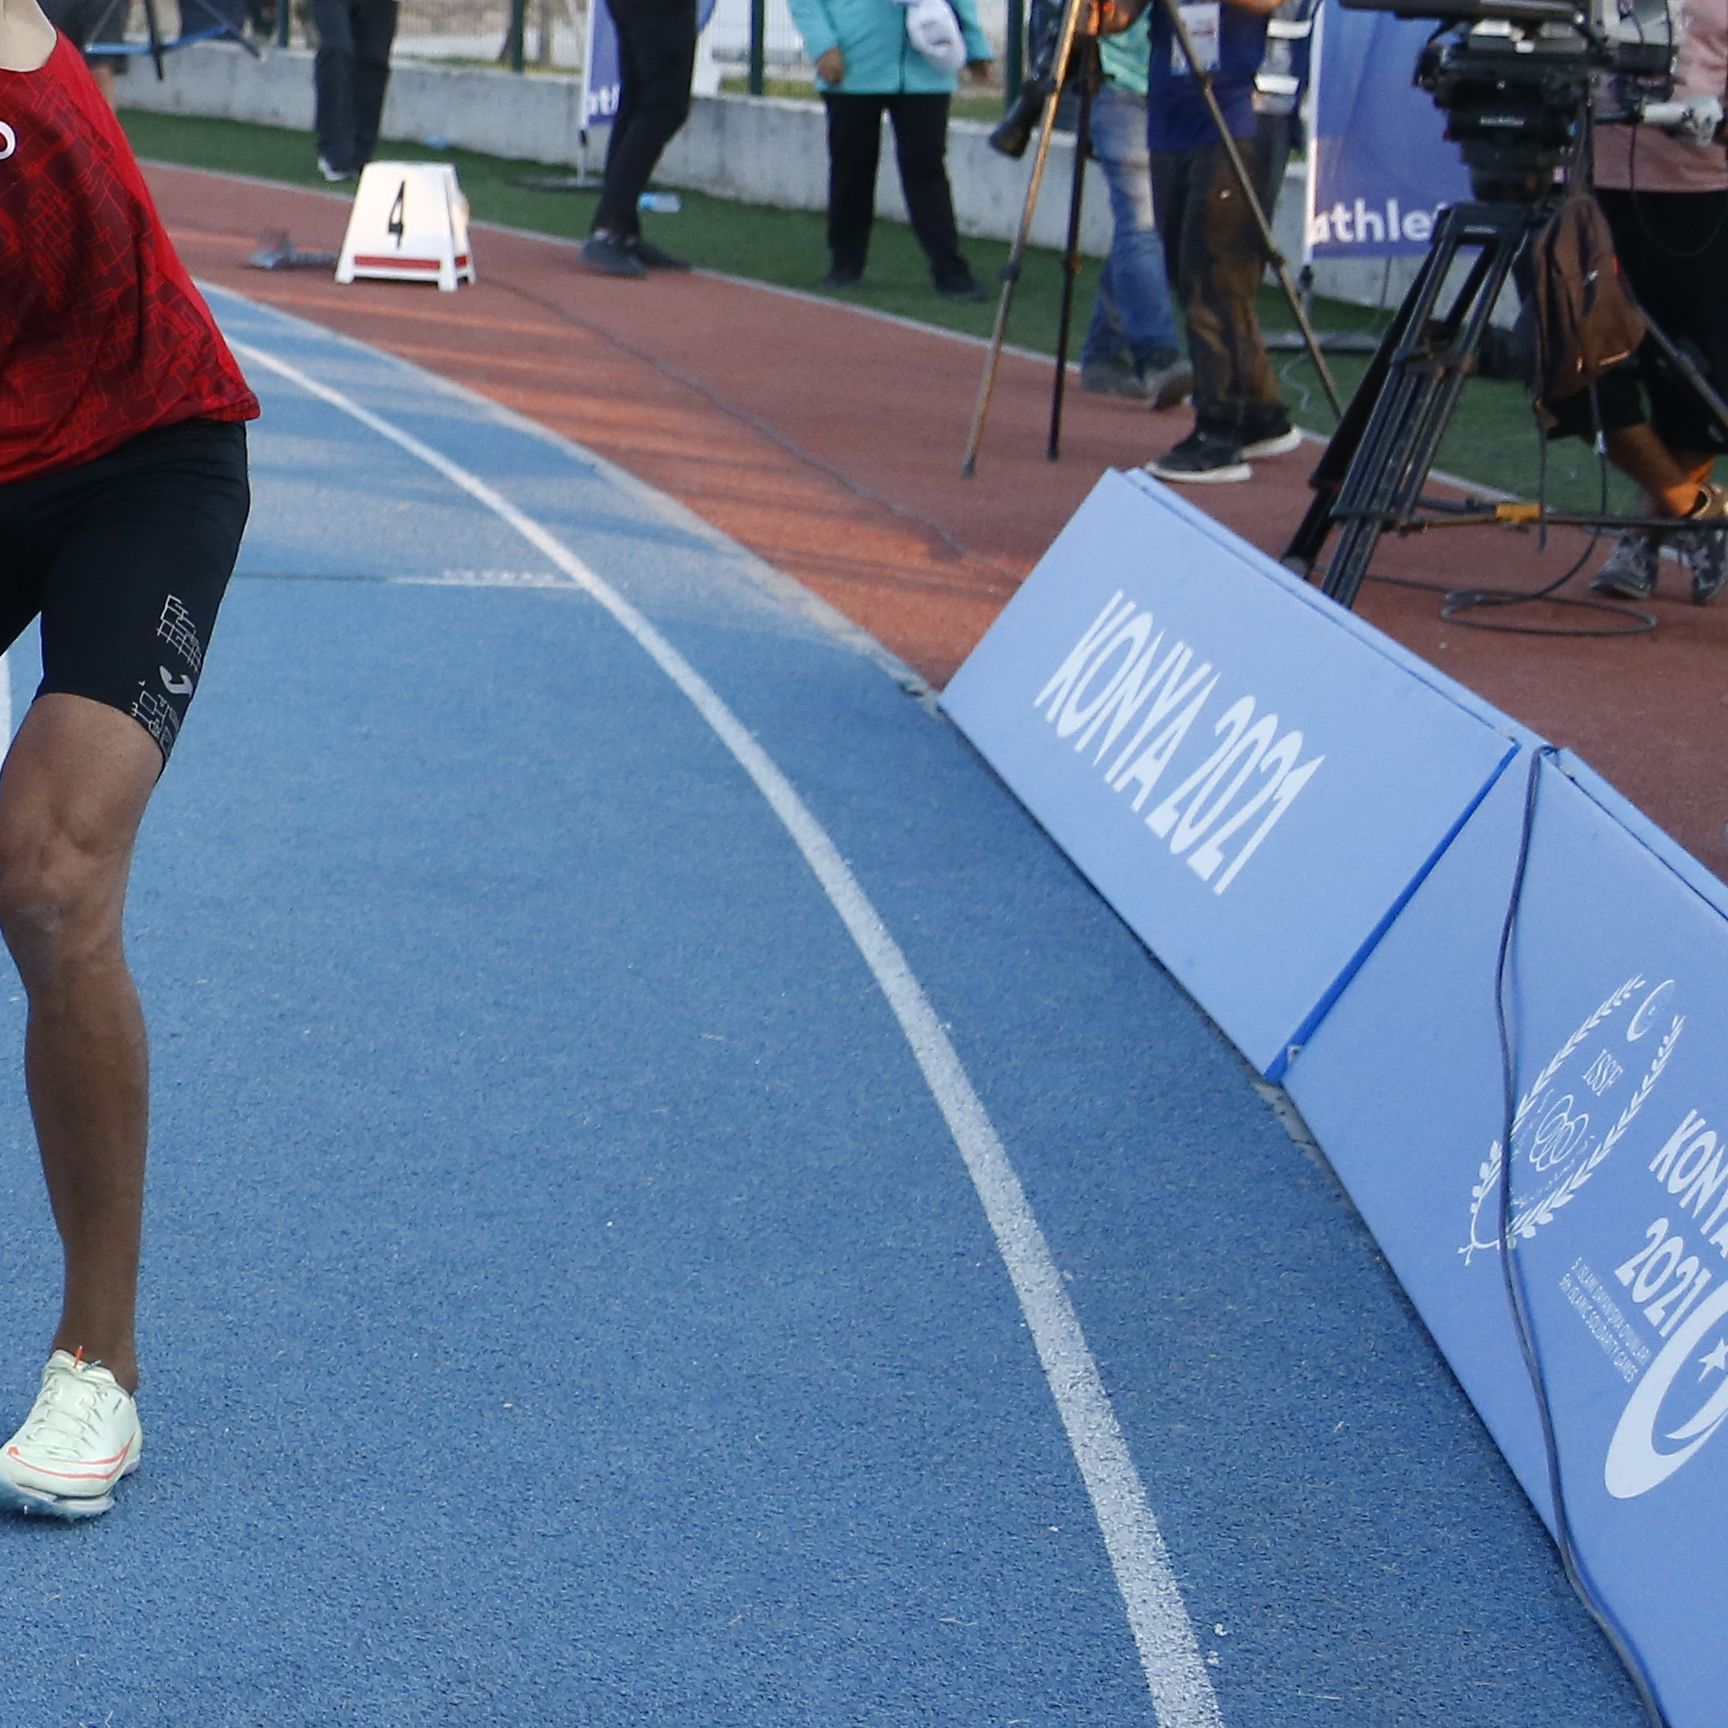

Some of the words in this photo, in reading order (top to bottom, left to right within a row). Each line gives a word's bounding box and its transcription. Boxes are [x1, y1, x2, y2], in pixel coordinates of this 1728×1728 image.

[387, 179, 407, 249] 4
[1034, 589, 1221, 813] KONYA
[1144, 695, 1326, 896] 2021
[1582, 1049, 1623, 1096] ISSF
[1614, 1217, 1713, 1338] 2021
